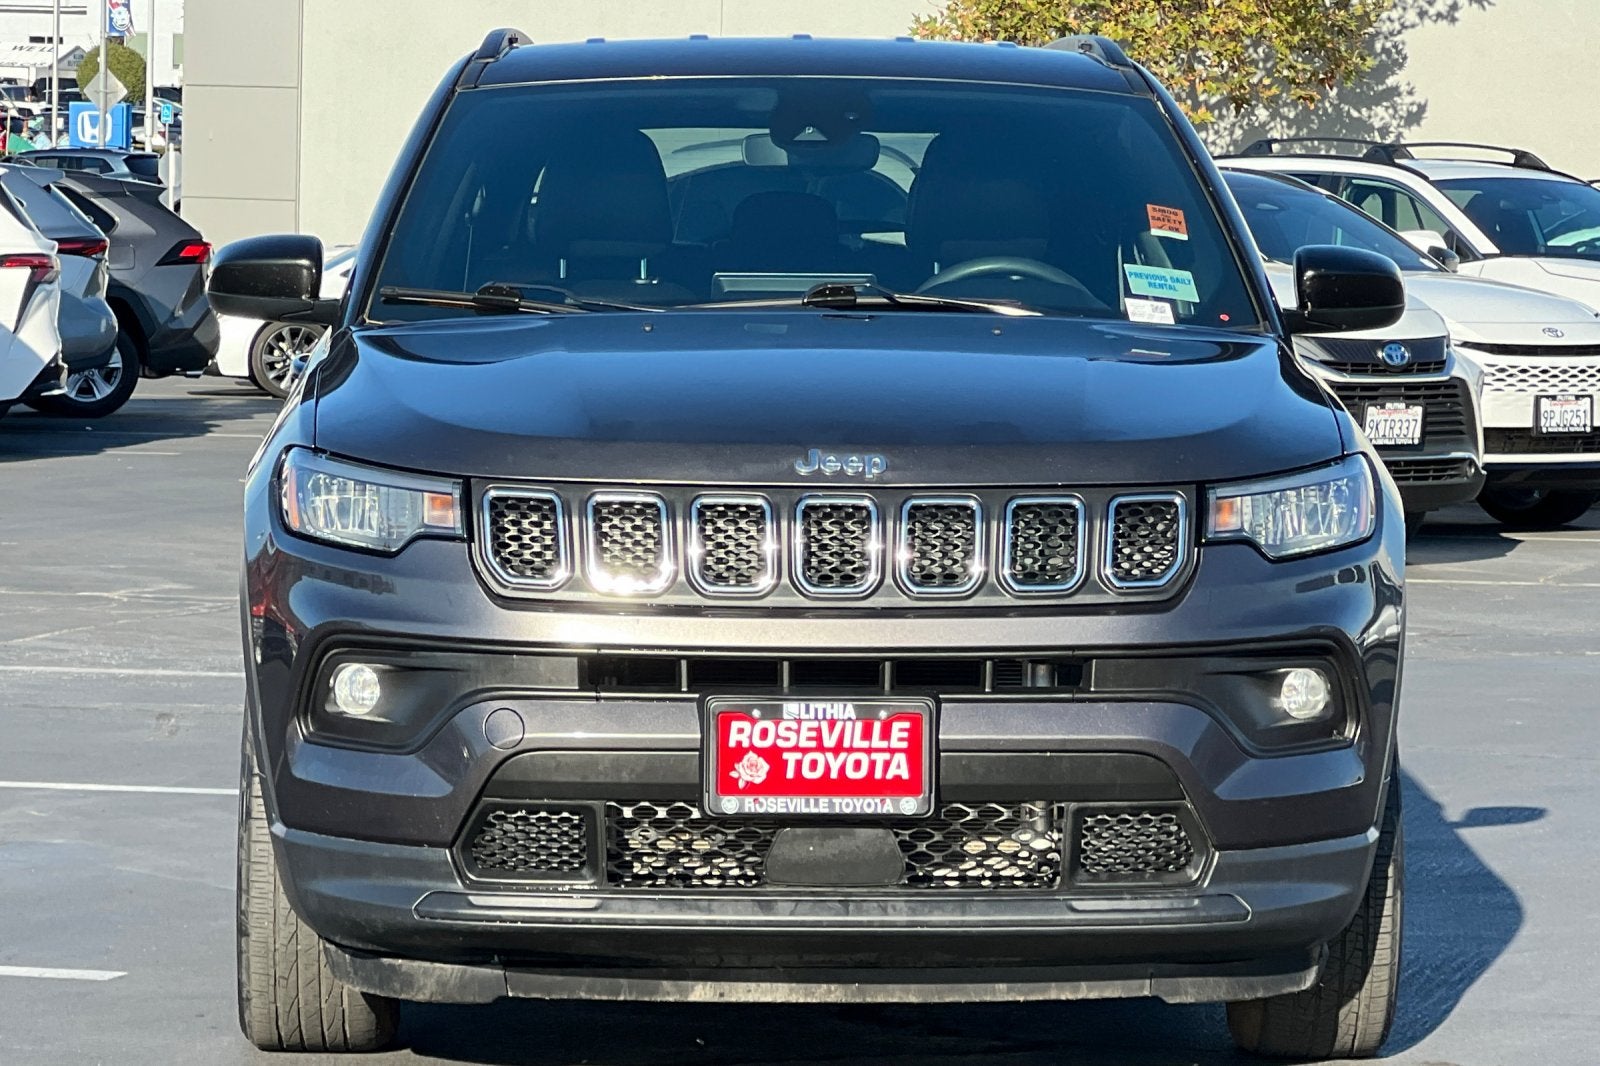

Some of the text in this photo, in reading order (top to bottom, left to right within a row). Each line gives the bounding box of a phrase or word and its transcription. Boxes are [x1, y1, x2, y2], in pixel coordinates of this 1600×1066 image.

[1151, 207, 1179, 216] SMOG
[1150, 216, 1182, 225] SAFETY
[1128, 271, 1191, 285] PREVIOUS DAILY
[1147, 281, 1178, 291] RENTAL
[1542, 410, 1588, 428] 9PJG251
[1367, 418, 1418, 439] 9KIR337
[794, 448, 888, 479] Jeep
[800, 703, 857, 720] LITHIA
[728, 720, 911, 748] ROSEVILLE
[782, 752, 910, 780] TOYOTA
[744, 797, 893, 814] ROSEVILLE TOYOTA
